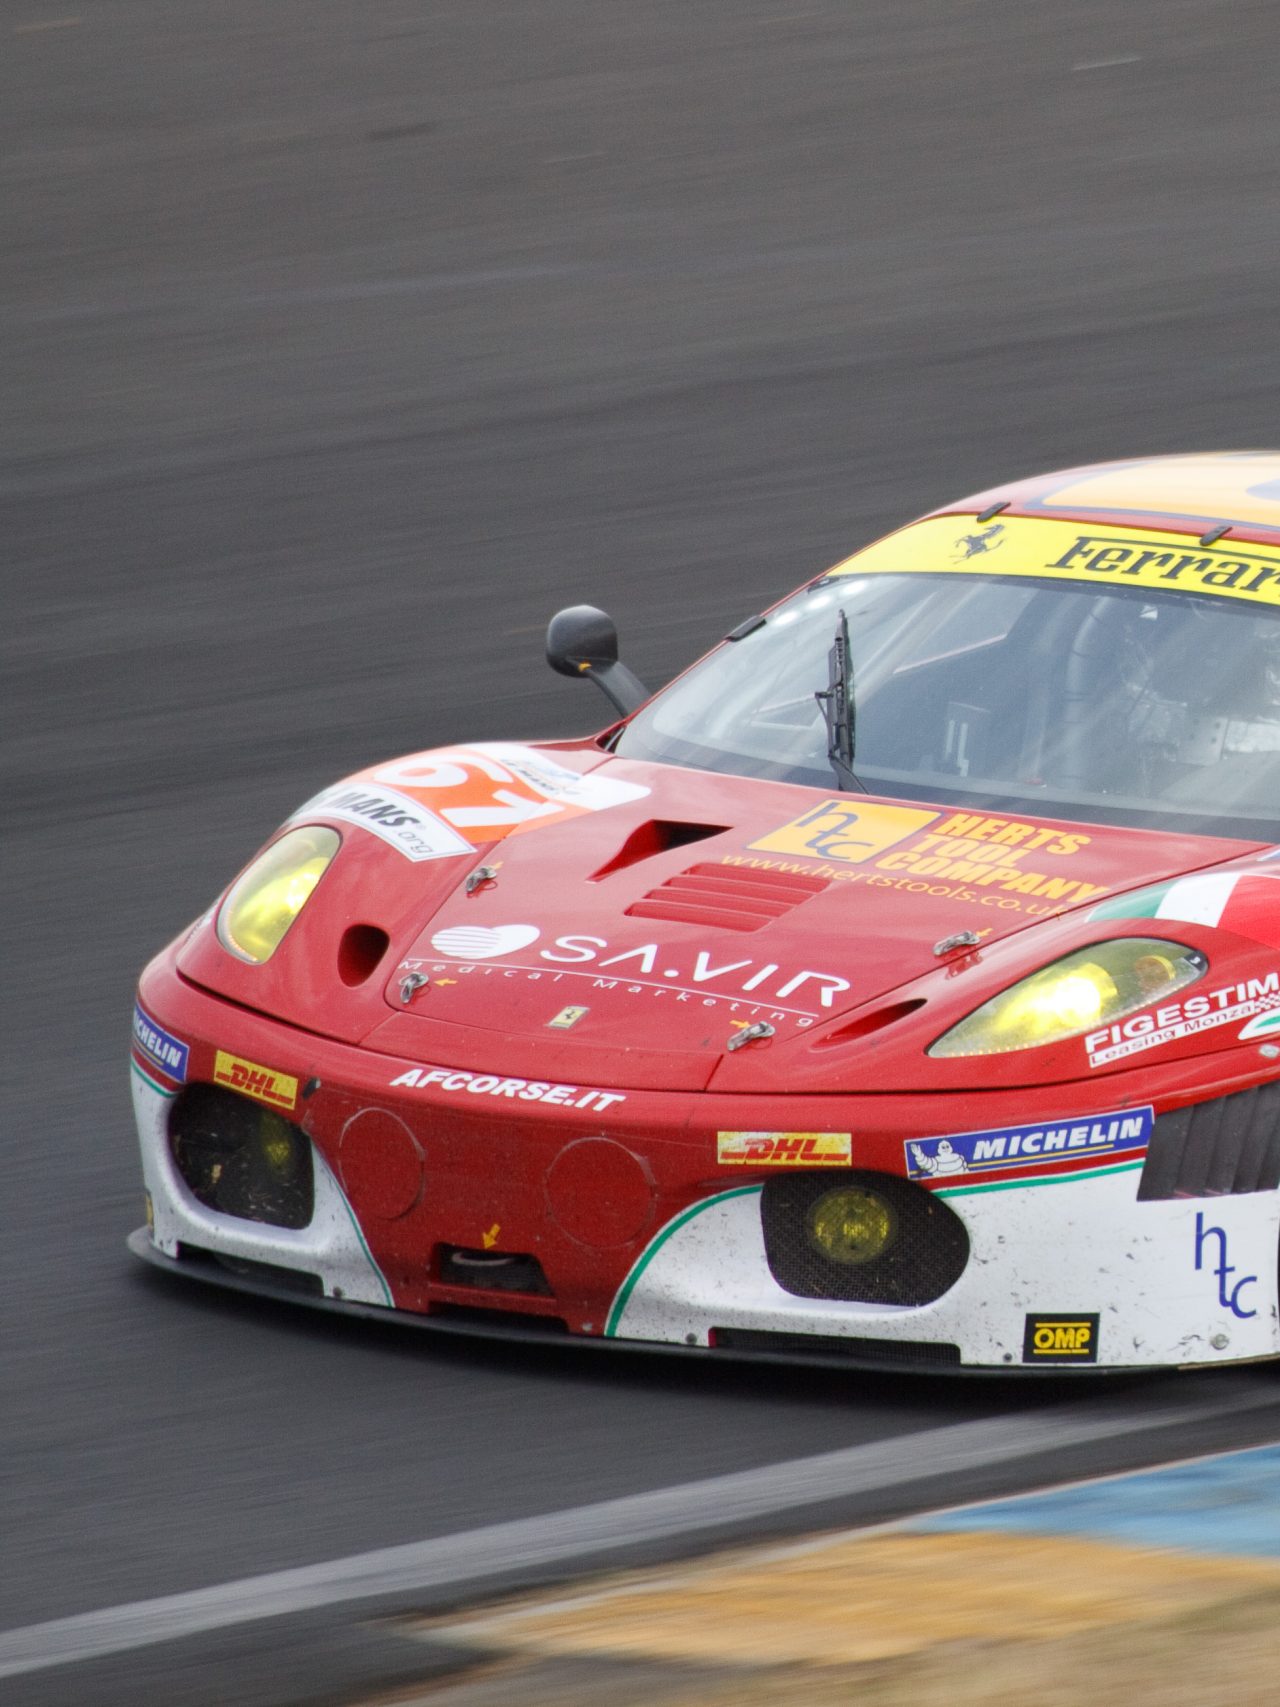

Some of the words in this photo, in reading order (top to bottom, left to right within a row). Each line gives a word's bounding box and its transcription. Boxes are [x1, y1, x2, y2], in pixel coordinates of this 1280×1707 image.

[796, 803, 874, 860] htc
[911, 835, 1031, 868] TOOL
[930, 814, 1092, 855] HERTS
[720, 856, 1068, 916] www.hertstools.co.uk
[874, 853, 1111, 902] COMPANY
[398, 960, 562, 983] Medical
[592, 978, 814, 1028] Marketing
[1084, 972, 1280, 1054] FIGESTIM
[1091, 1029, 1177, 1065] Leasing
[1184, 1004, 1253, 1033] Monza
[229, 1063, 281, 1099] DHL
[389, 1068, 627, 1112] AFCORSE.IT
[743, 1138, 826, 1161] DHL
[972, 1116, 1144, 1160] MICHELIN
[1195, 1212, 1257, 1319] htc
[1034, 1327, 1091, 1351] OMP
